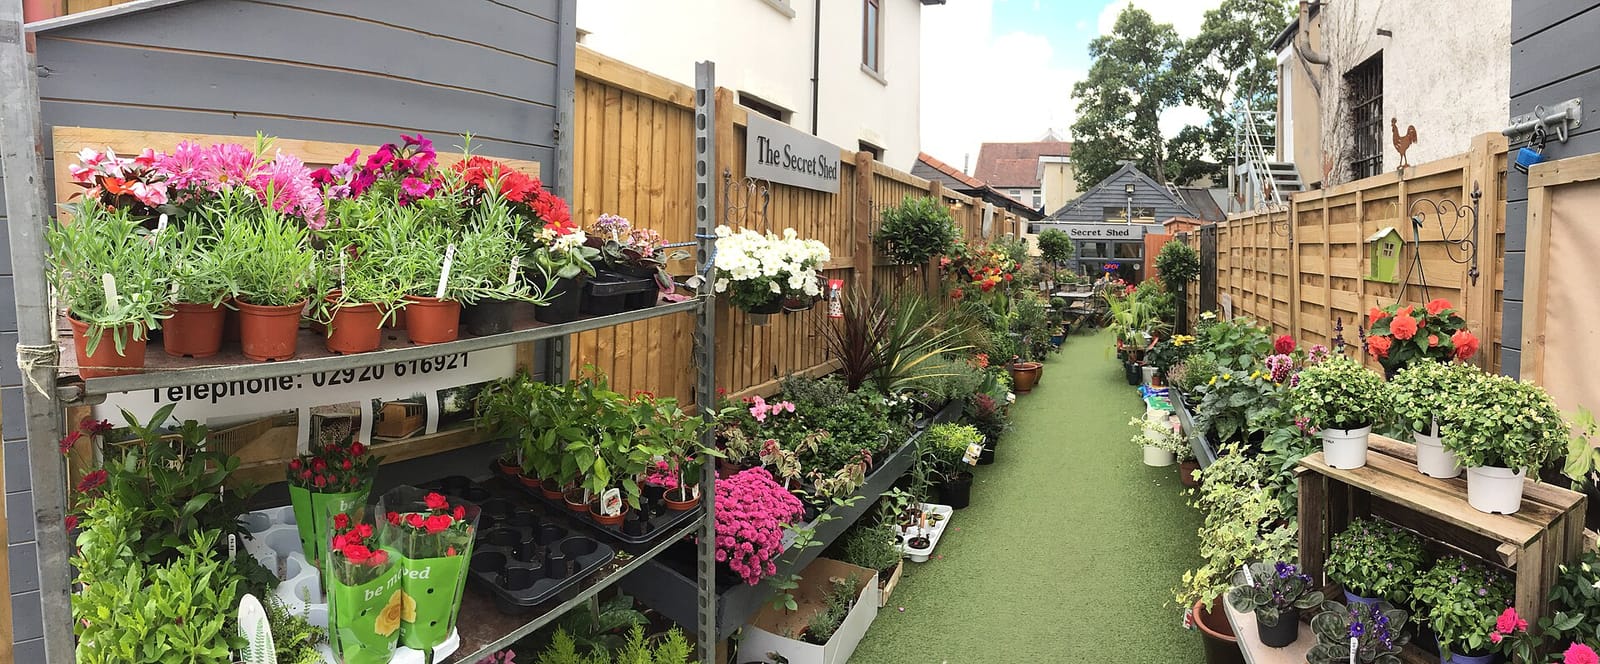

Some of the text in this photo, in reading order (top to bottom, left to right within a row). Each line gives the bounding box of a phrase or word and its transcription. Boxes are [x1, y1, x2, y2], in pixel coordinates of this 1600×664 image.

[757, 135, 838, 180] The Secret Shed
[1071, 228, 1101, 237] Secret
[1106, 228, 1130, 237] Shed
[312, 365, 385, 387] 02920
[394, 352, 469, 377] 616921
[364, 586, 384, 602] be
